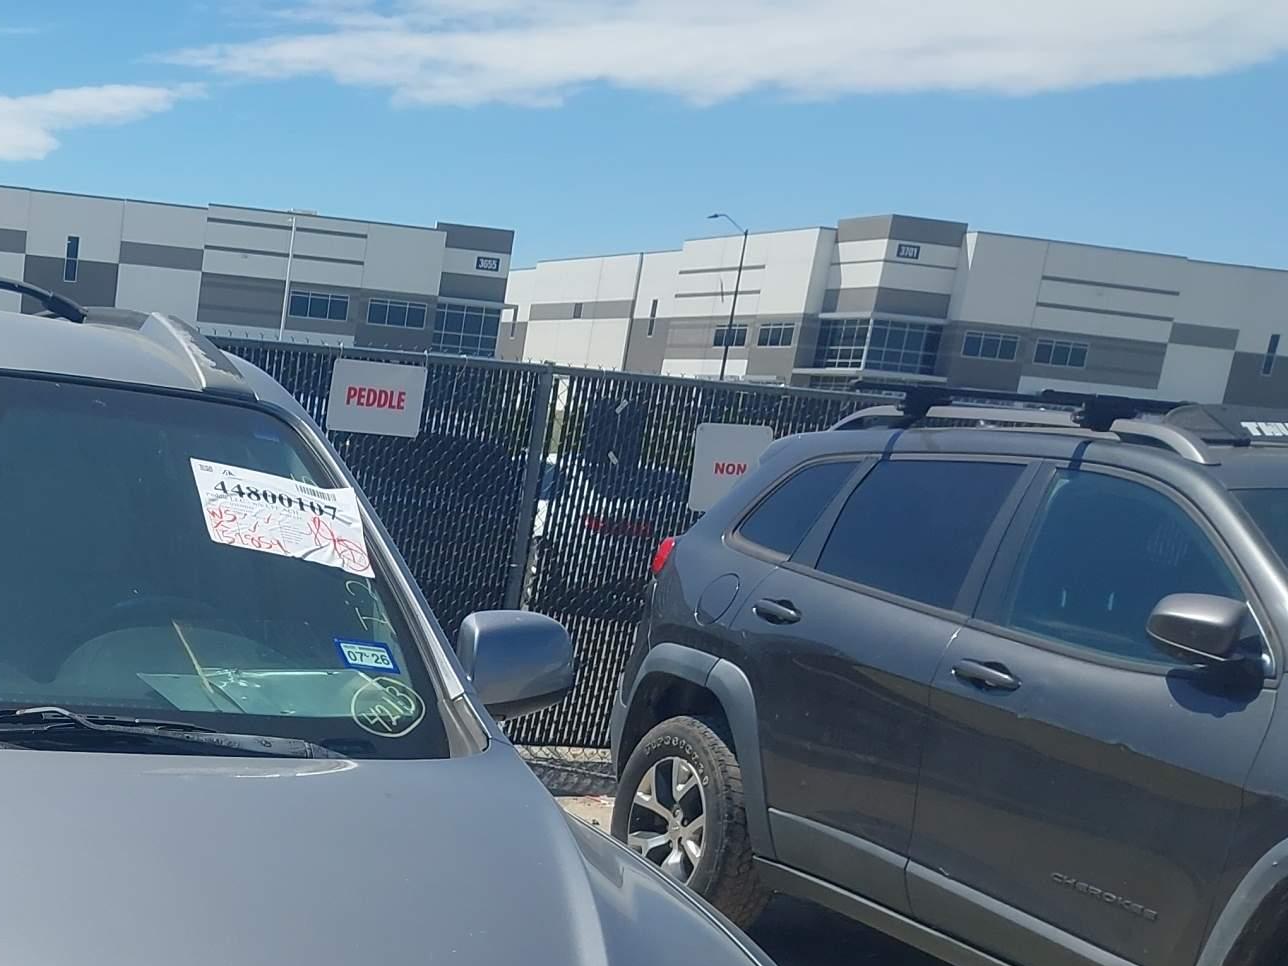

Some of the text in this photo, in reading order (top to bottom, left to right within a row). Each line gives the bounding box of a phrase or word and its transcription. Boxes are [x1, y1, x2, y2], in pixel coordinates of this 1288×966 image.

[345, 386, 407, 411] PEDDLE
[213, 480, 337, 520] 44800107
[347, 650, 391, 666] 07 26
